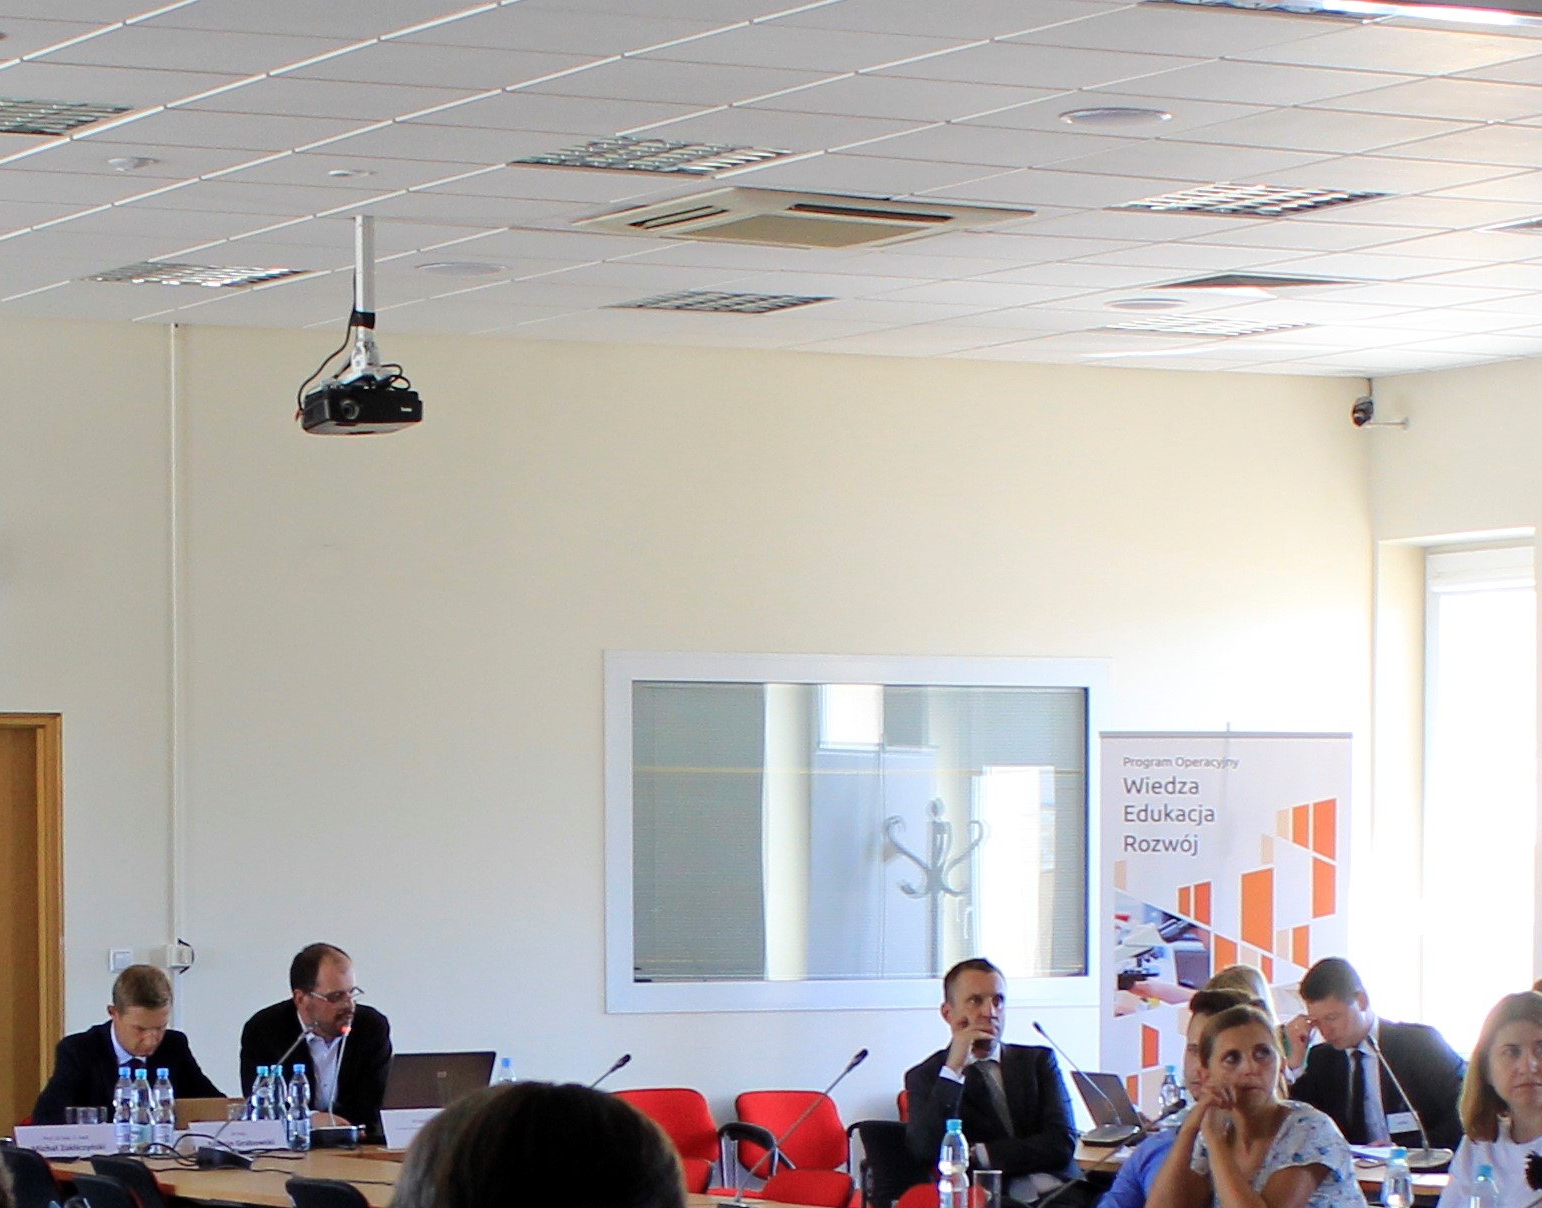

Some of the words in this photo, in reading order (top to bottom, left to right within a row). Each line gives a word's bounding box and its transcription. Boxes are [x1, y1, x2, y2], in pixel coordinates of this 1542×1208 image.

[1122, 756, 1173, 769] Program
[1175, 756, 1239, 770] Operacyjny
[1123, 776, 1200, 795] Wiedza
[1123, 803, 1215, 827] Edukacja
[1123, 833, 1199, 857] Rozwój
